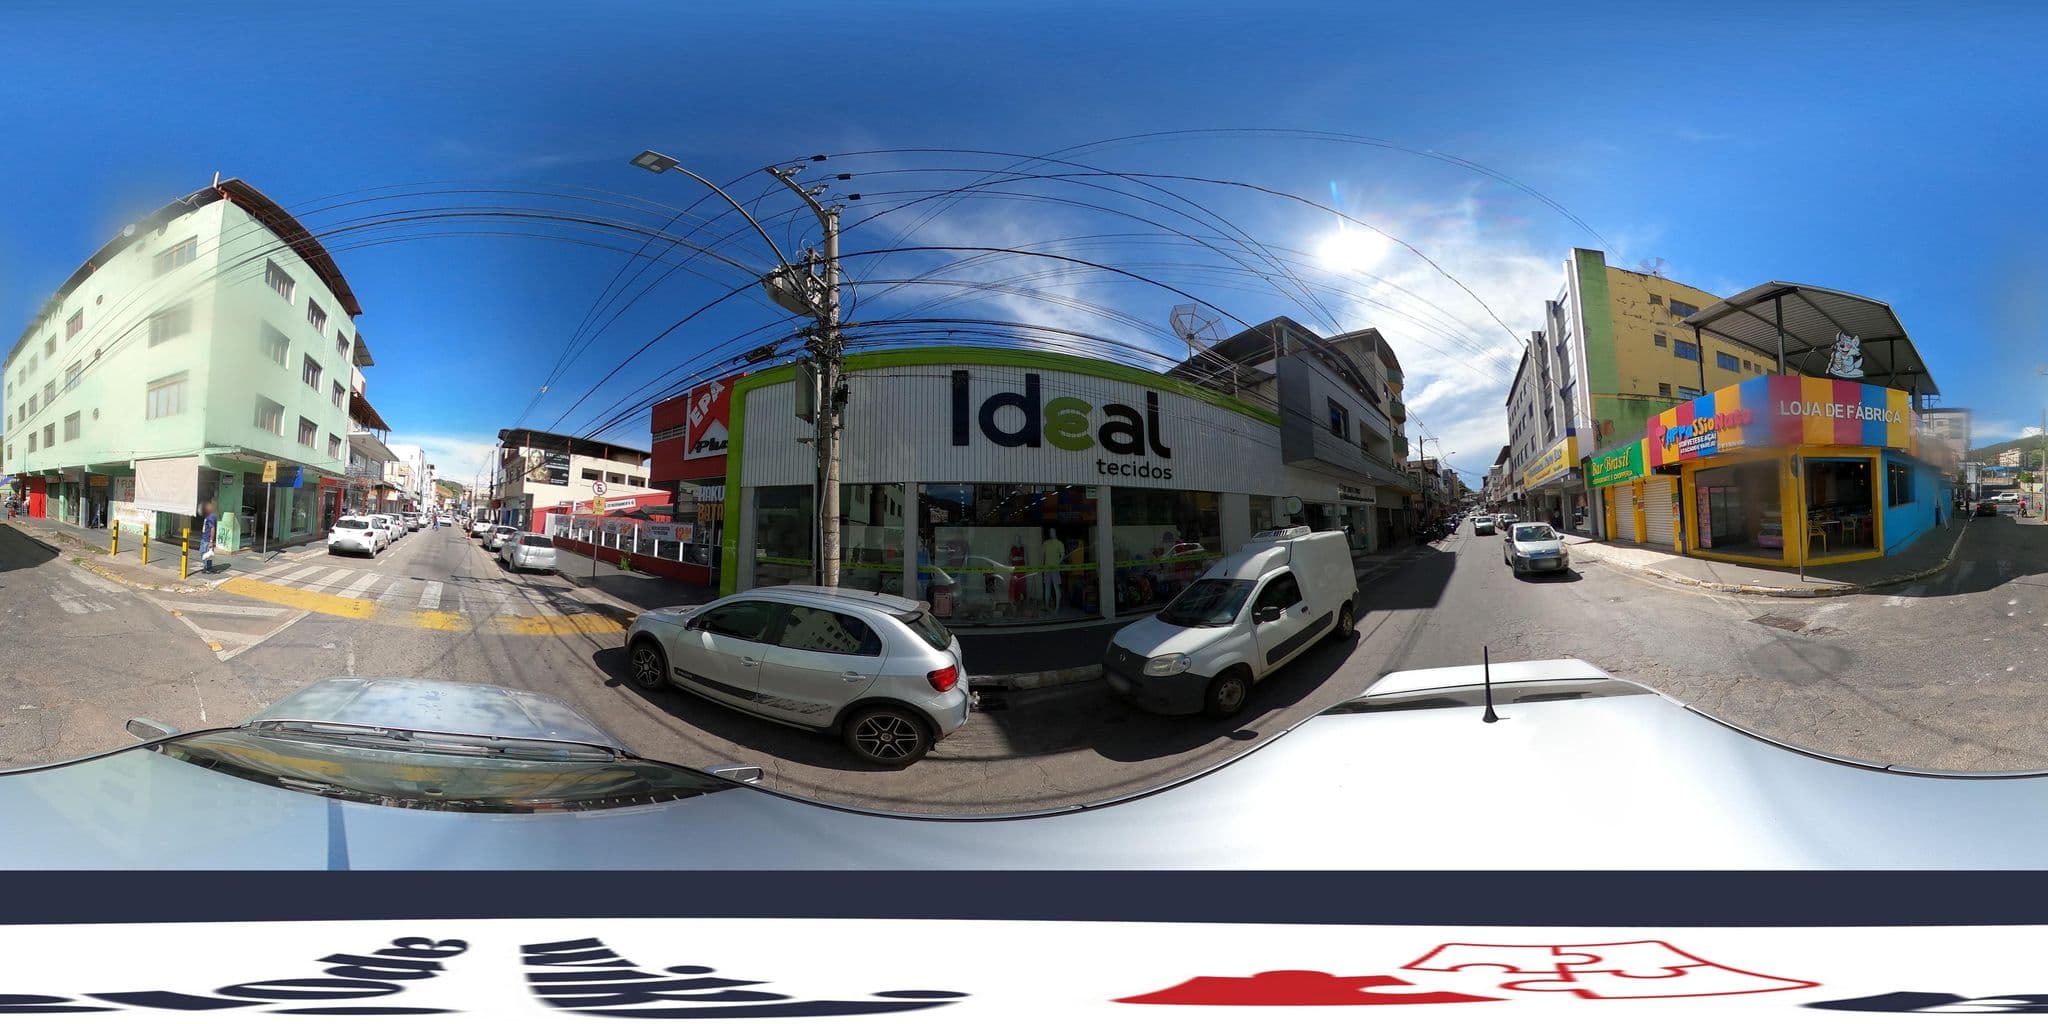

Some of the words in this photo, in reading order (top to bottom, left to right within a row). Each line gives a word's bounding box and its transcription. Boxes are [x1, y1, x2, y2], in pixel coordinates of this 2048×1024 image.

[691, 381, 726, 428] EPA
[952, 370, 1171, 458] Ideal
[1780, 400, 1822, 416] LOJA
[1825, 403, 1844, 418] DE
[1847, 402, 1901, 423] FÁBRICA
[1096, 458, 1172, 479] tecidos
[1592, 462, 1604, 476] Bar
[1604, 446, 1631, 472] Brasil
